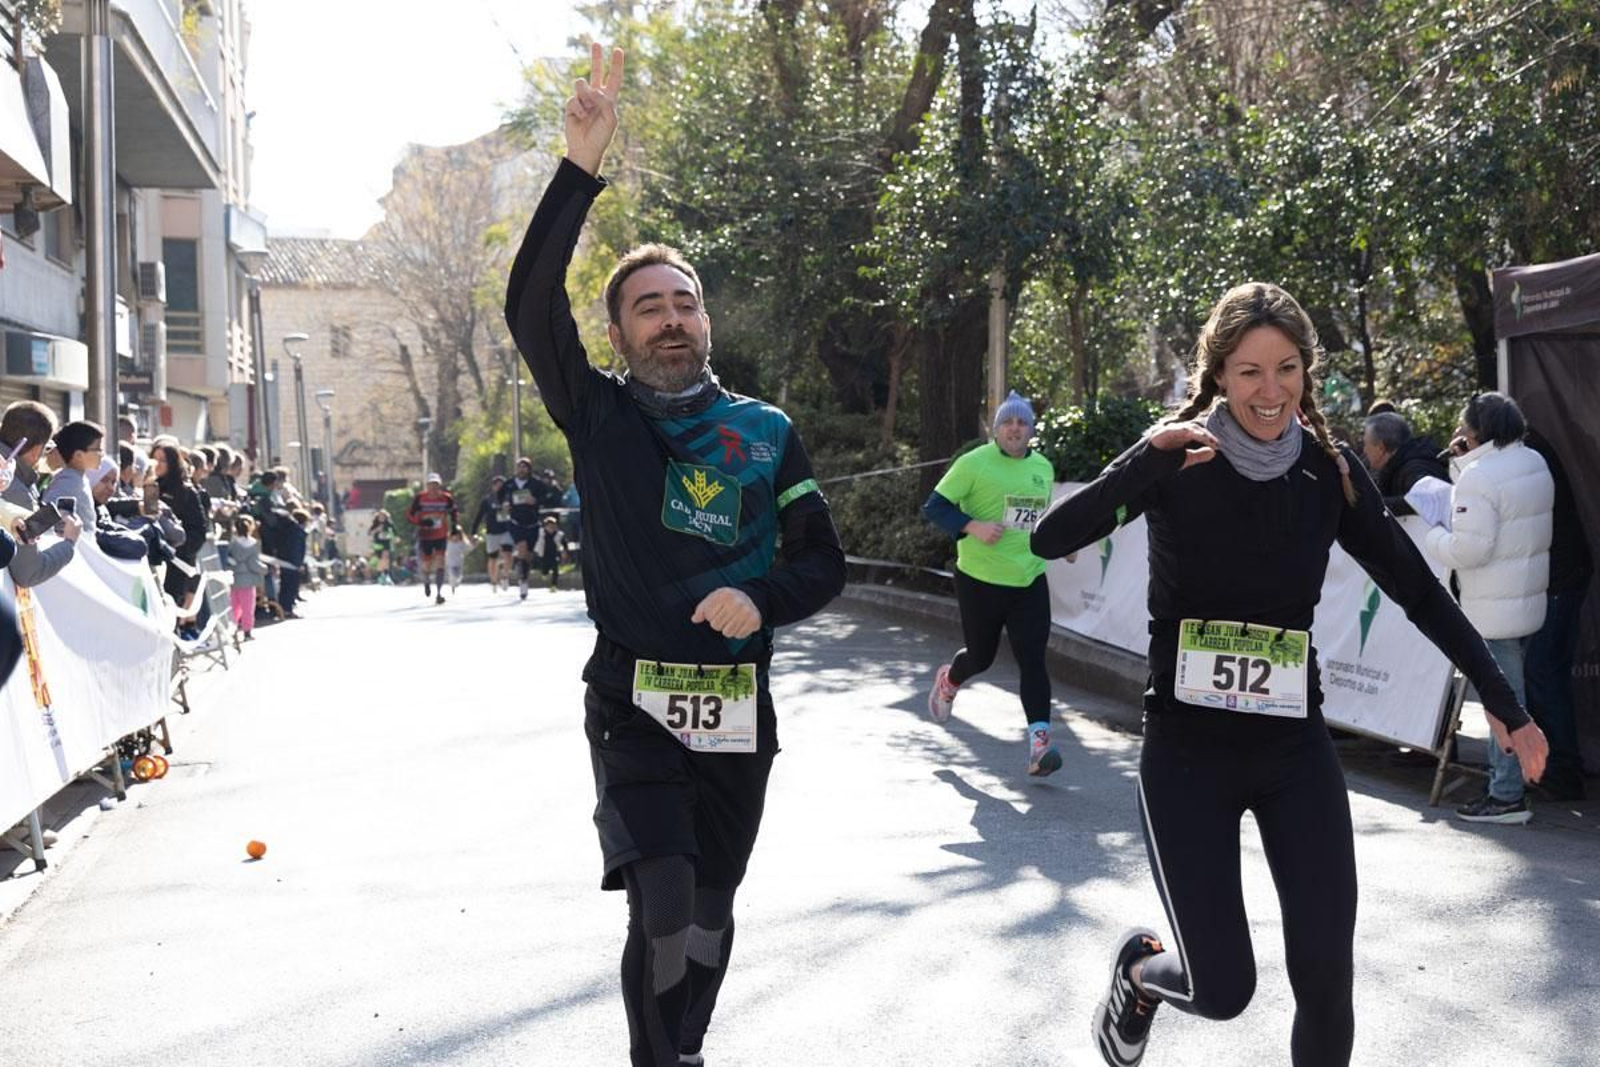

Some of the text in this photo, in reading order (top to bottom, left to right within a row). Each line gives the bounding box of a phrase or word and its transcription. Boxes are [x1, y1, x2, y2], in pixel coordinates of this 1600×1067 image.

[695, 509, 732, 526] RURAL
[1200, 636, 1230, 651] CARRERA
[1233, 639, 1263, 652] POPULAR
[1212, 654, 1272, 696] 512
[654, 676, 683, 690] CARRERA
[686, 680, 715, 692] POPULAR
[666, 694, 723, 730] 513
